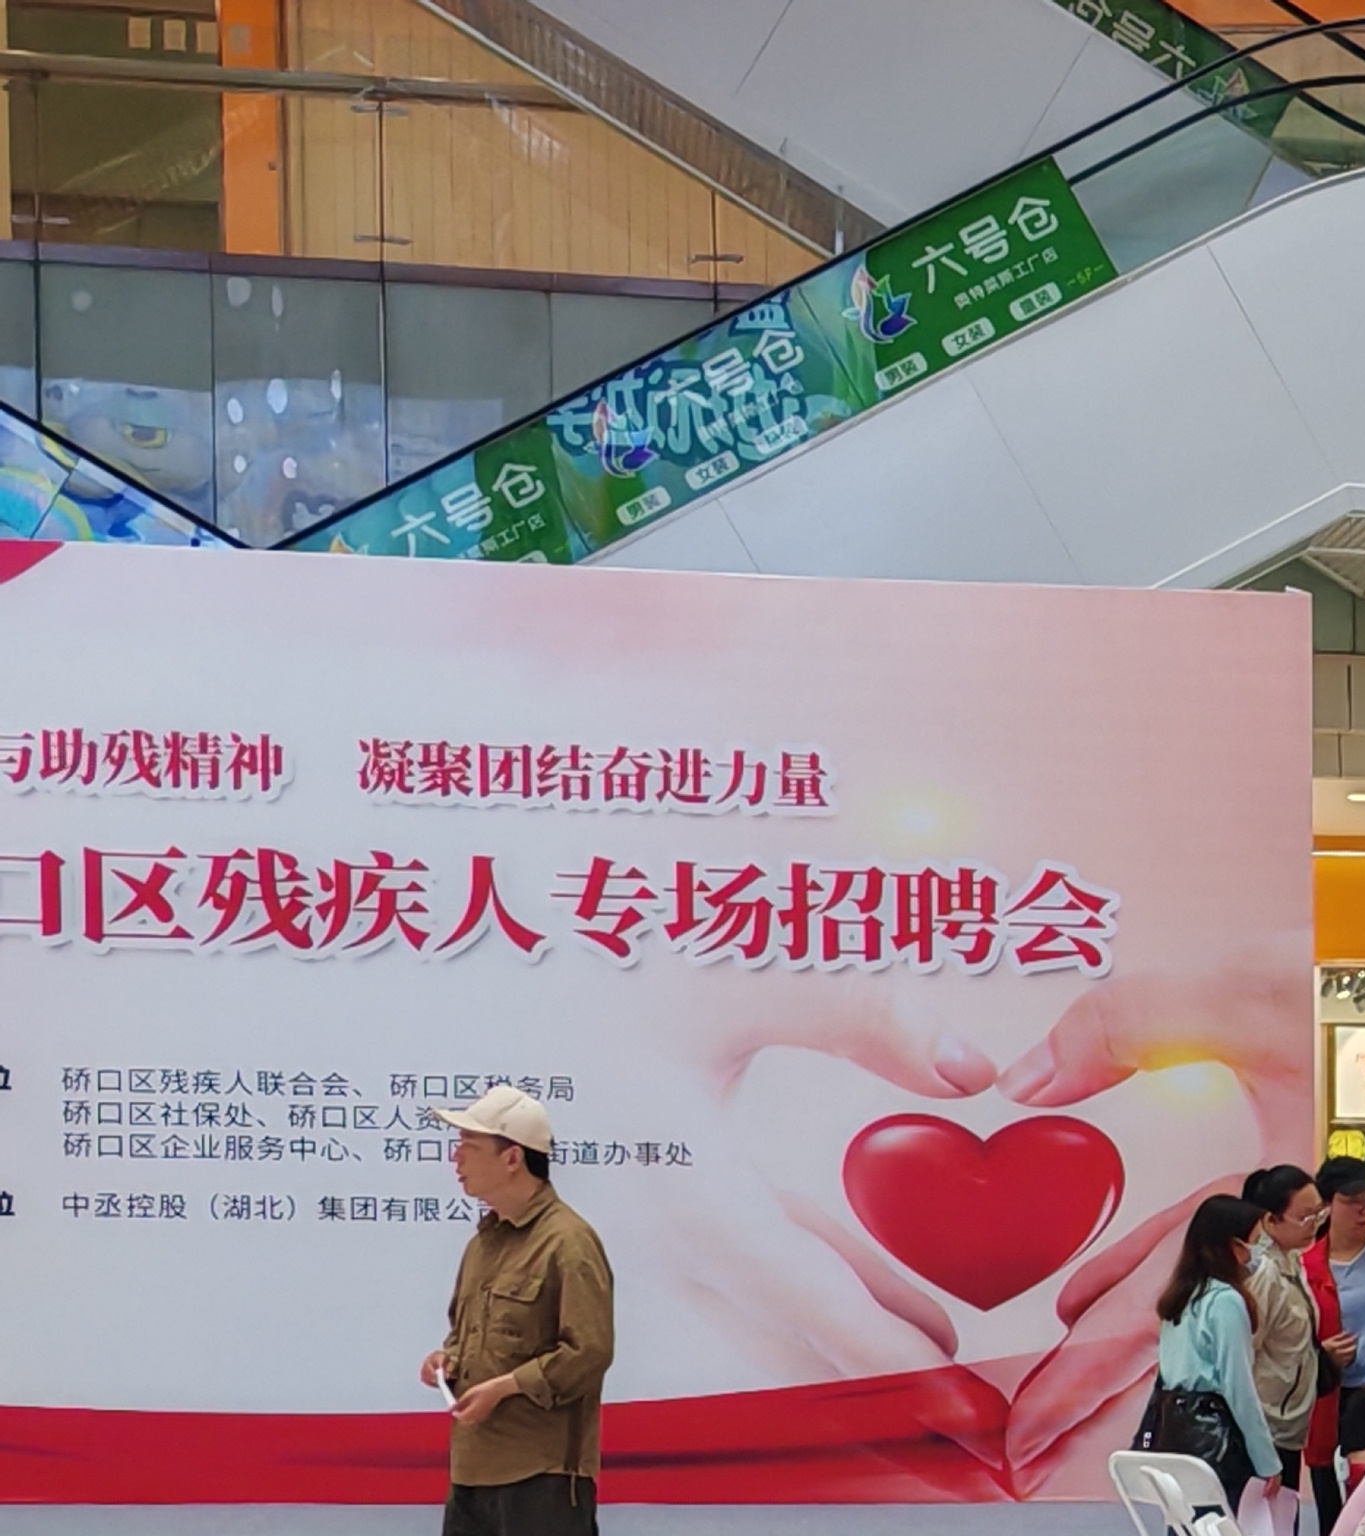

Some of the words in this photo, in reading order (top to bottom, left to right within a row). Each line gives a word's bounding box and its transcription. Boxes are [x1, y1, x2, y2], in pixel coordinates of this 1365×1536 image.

[911, 196, 1059, 294] 六号仓
[391, 463, 545, 557] 六号仓
[357, 737, 828, 807] 凝聚团结奋进力量
[0, 845, 1112, 968] 口区残疾人专场招聘会
